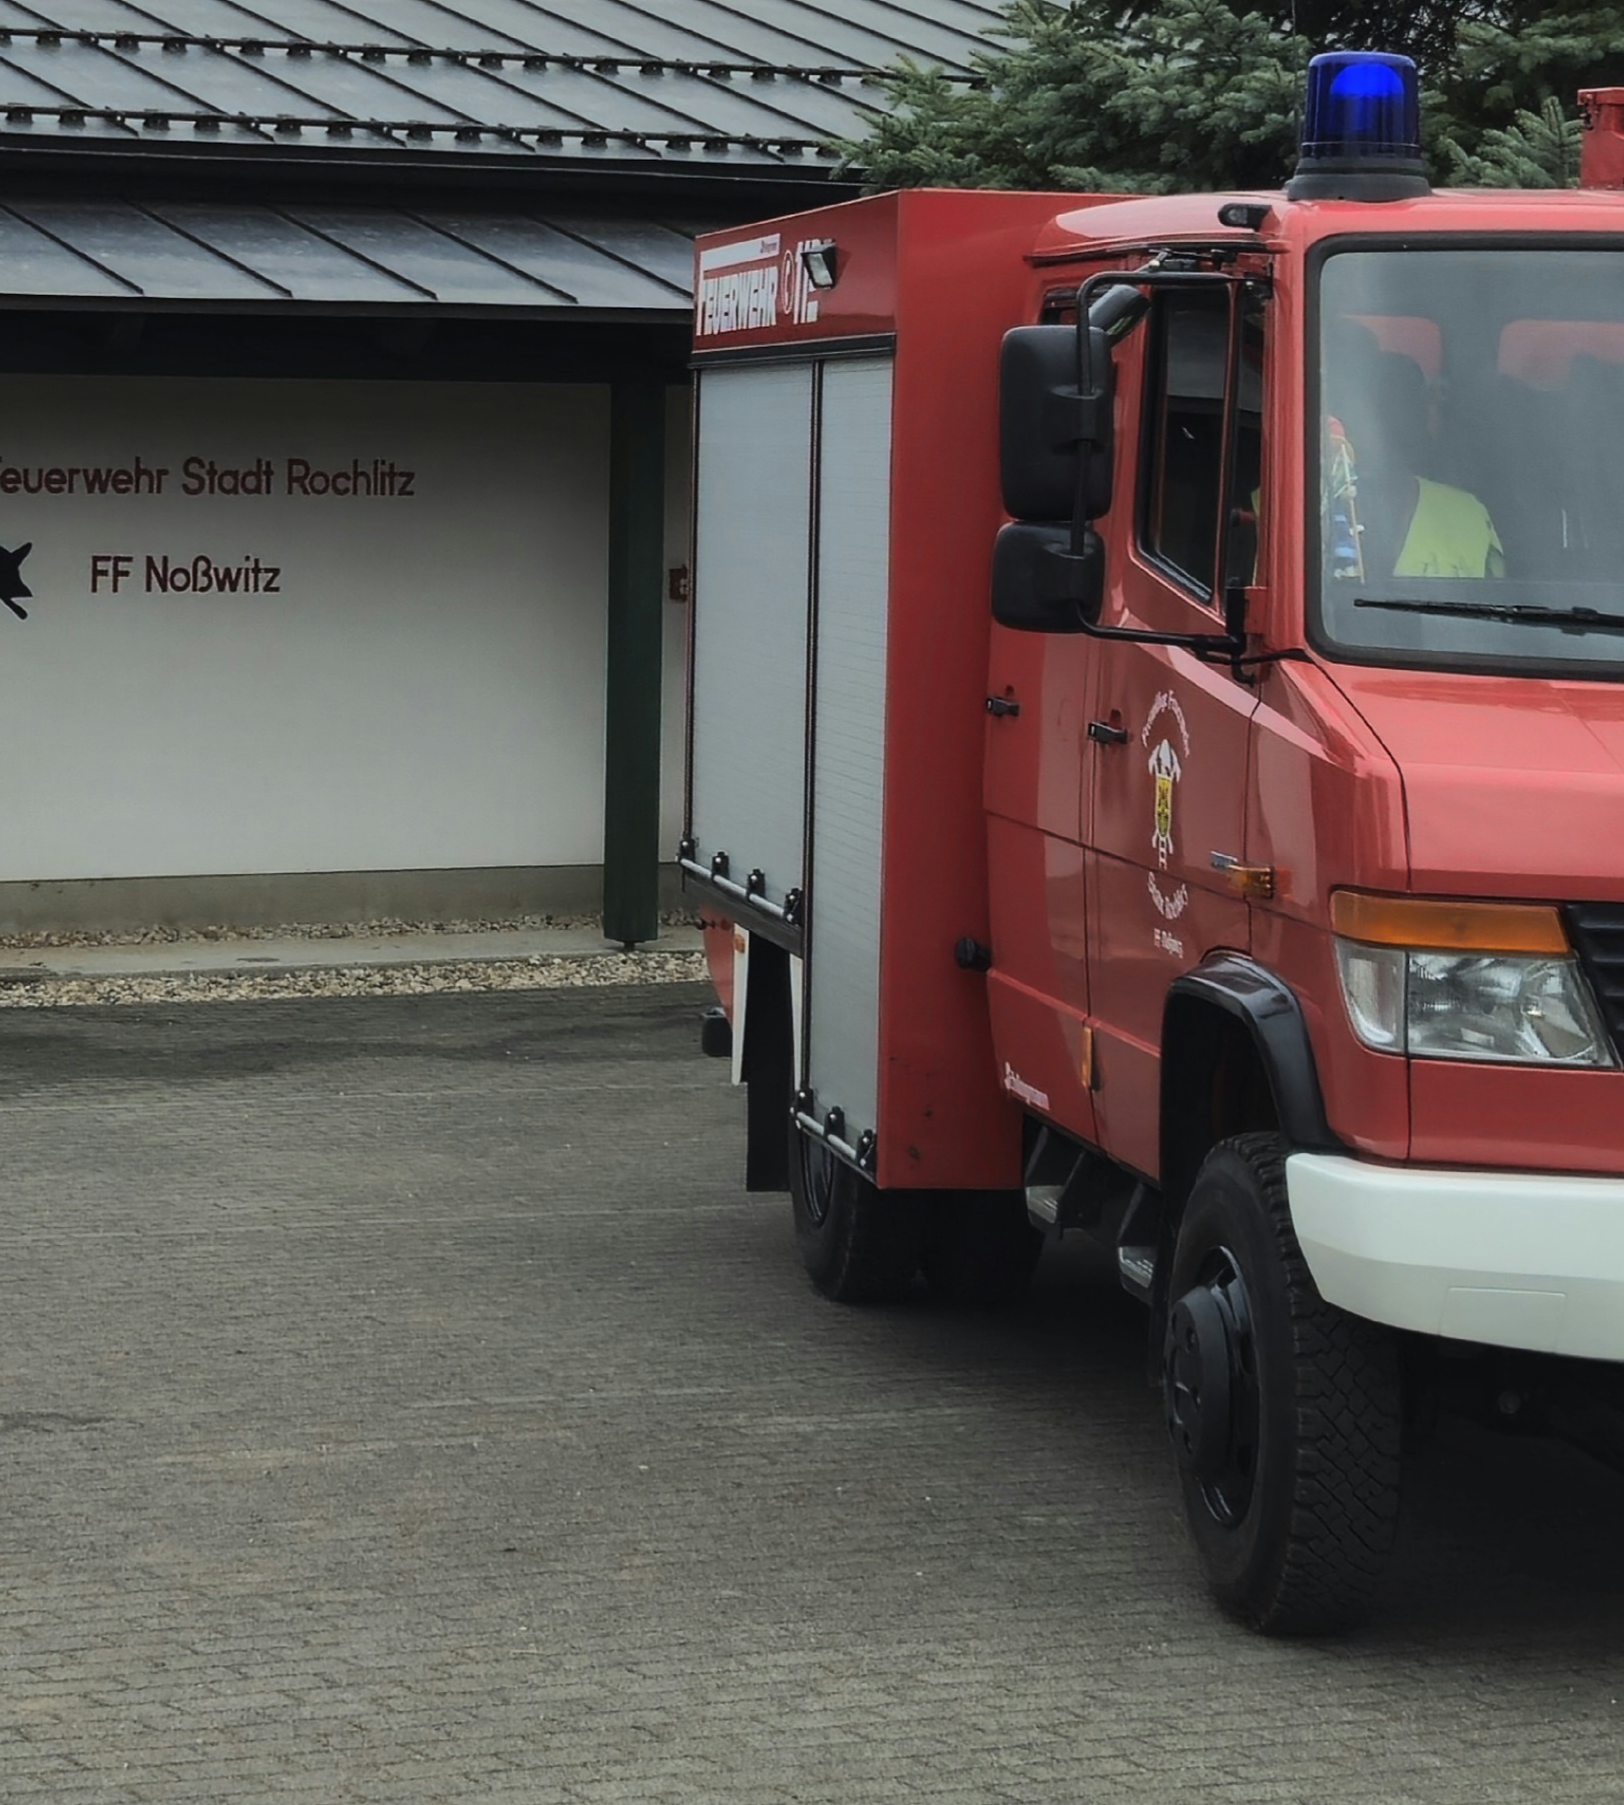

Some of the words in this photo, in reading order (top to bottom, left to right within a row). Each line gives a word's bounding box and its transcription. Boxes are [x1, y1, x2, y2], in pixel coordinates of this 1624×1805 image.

[696, 242, 779, 336] FEUERWEHR
[182, 456, 274, 495] Stadt
[286, 458, 415, 496] Rochlitz
[91, 555, 133, 593] FF
[145, 555, 281, 593] Noßwitz
